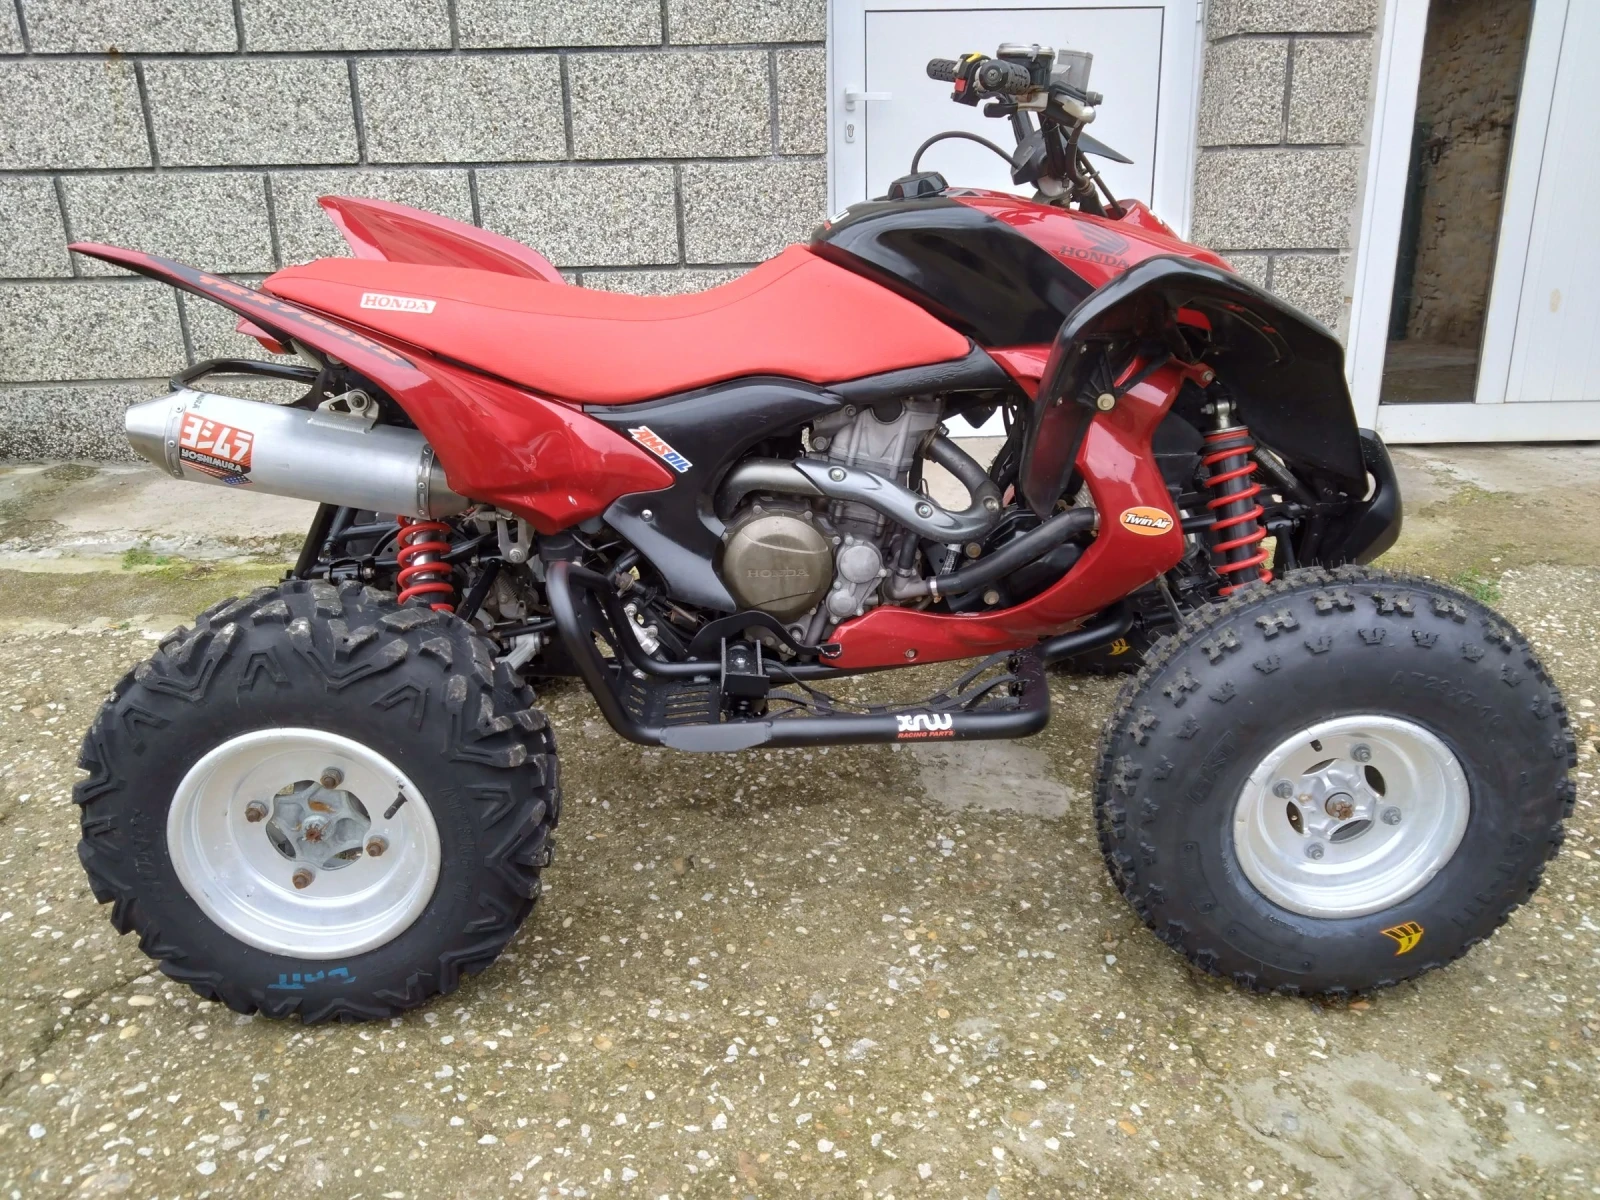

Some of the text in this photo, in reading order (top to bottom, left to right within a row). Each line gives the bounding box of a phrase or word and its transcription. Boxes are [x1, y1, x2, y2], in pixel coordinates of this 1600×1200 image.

[1060, 245, 1130, 269] HONDA
[363, 295, 430, 311] HONDA
[180, 415, 253, 463] ヨシムラ
[631, 428, 690, 472] AMSOIL
[181, 449, 243, 473] YOSHIMURA
[1124, 512, 1171, 529] Twin Air
[746, 568, 810, 578] HONDA
[898, 731, 928, 739] RACING
